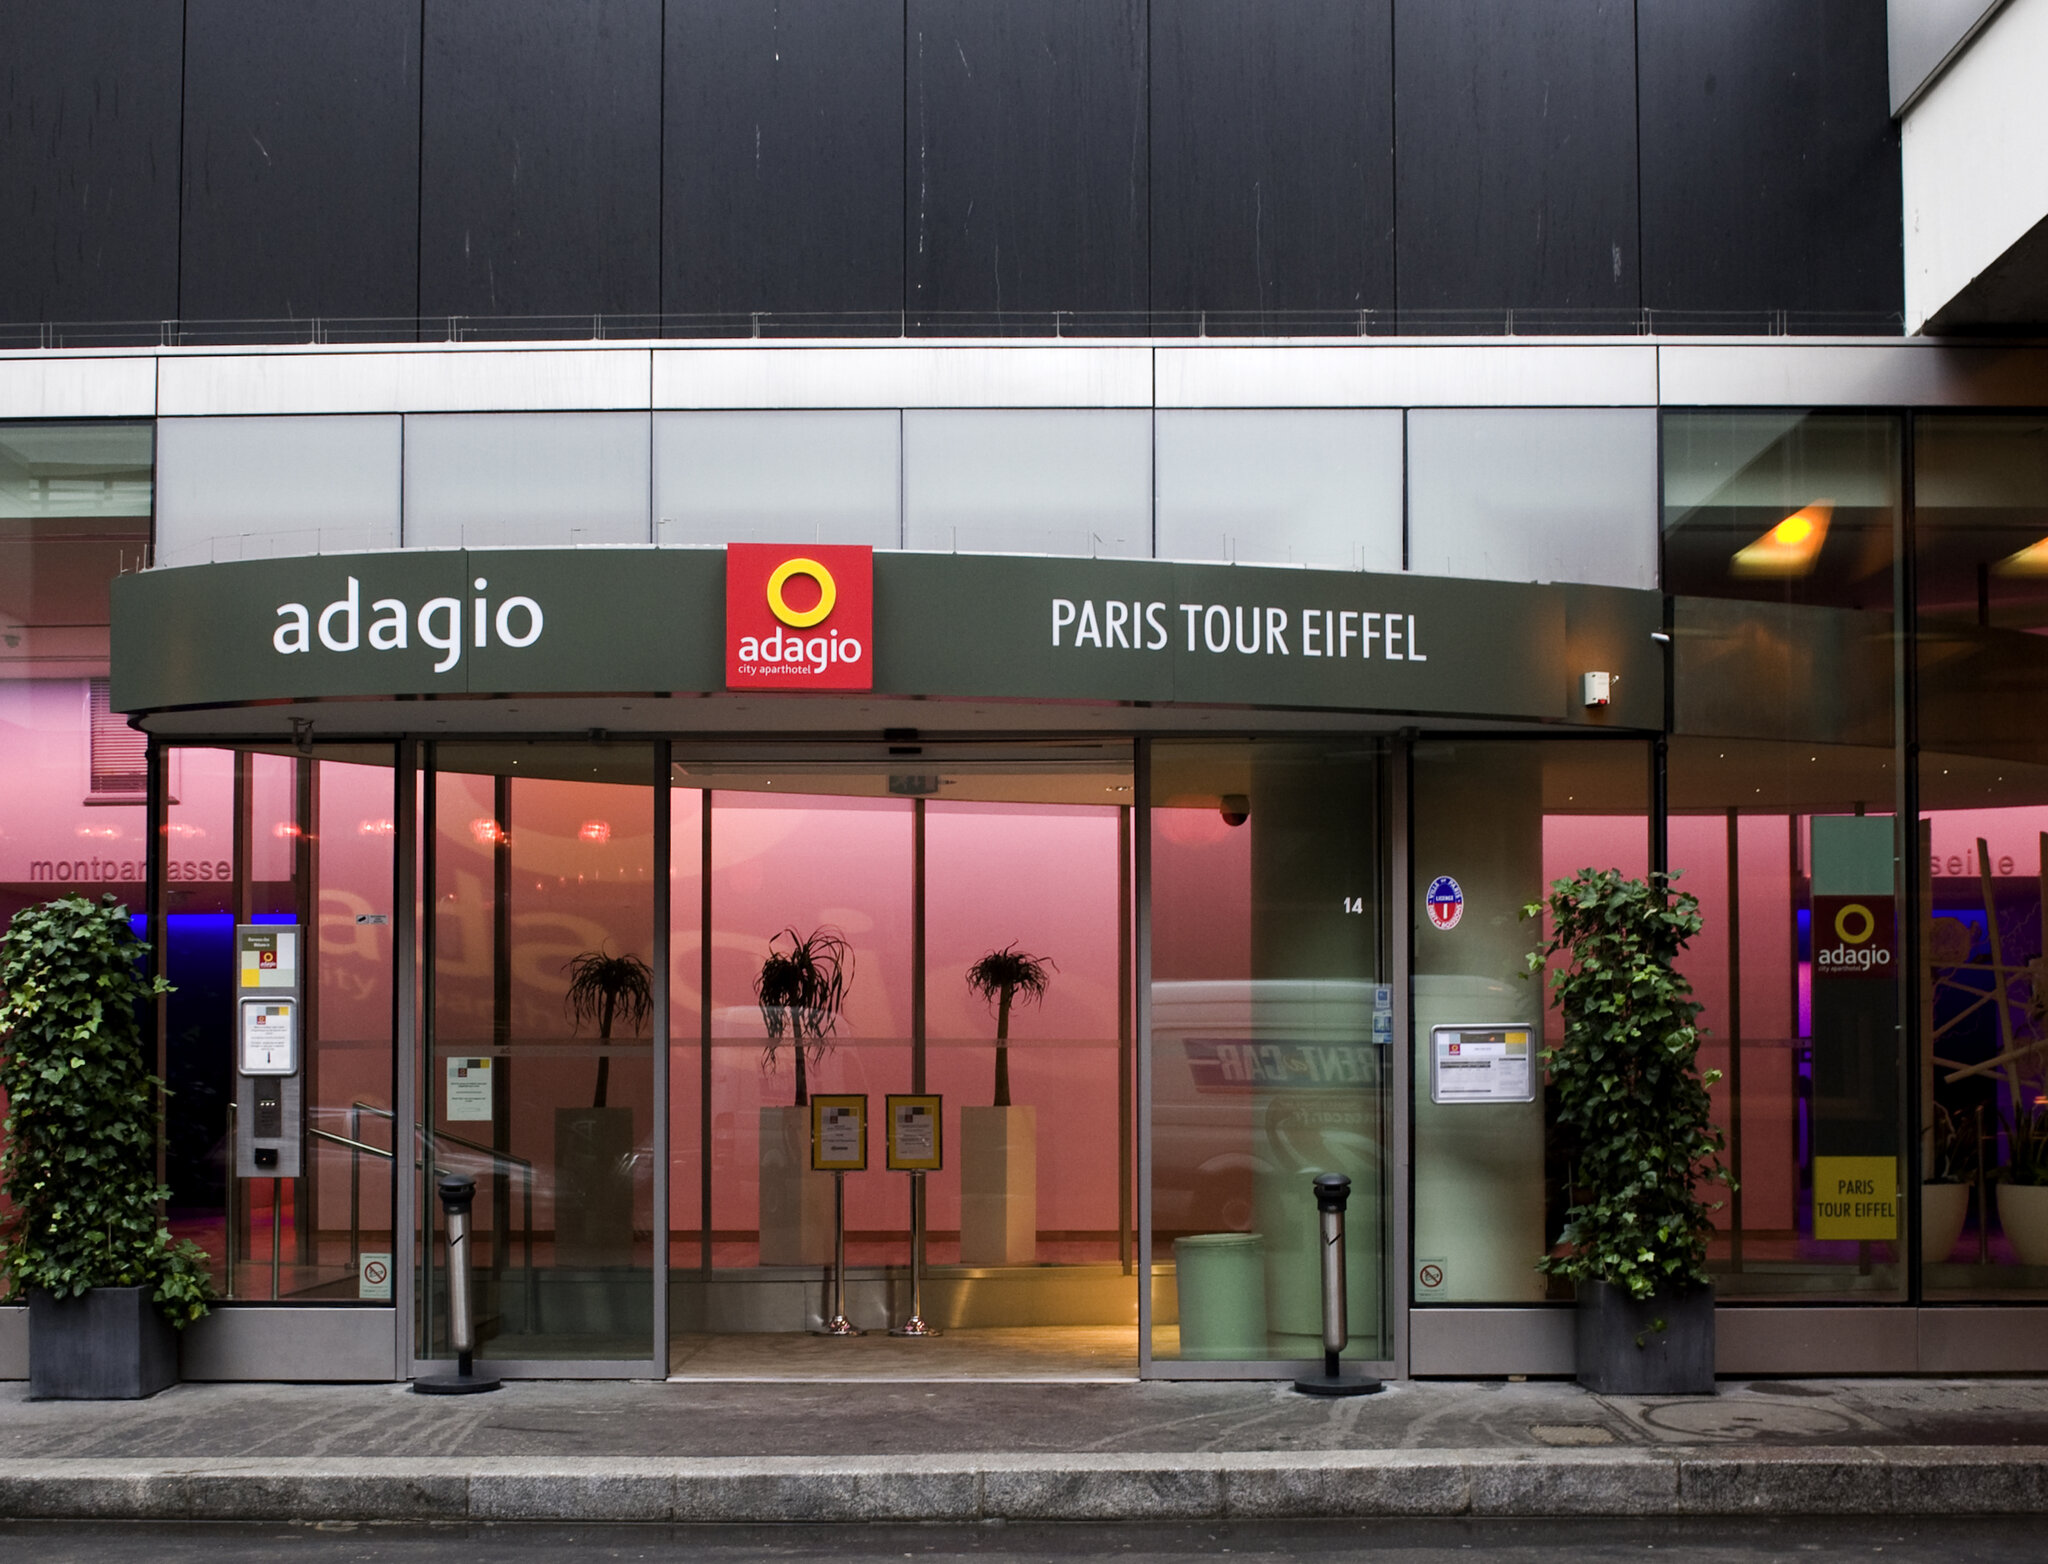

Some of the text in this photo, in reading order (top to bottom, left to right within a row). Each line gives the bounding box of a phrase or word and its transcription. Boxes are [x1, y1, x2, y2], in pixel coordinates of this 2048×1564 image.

[273, 576, 544, 673] adagio
[1052, 599, 1427, 663] PARIS TOUR EIFFEL
[738, 626, 862, 674] adagio
[738, 664, 811, 676] city aparthotel
[30, 856, 231, 882] montparasse
[1931, 848, 2014, 875] seie
[1343, 897, 1363, 914] 14
[1818, 943, 1890, 971] adagio
[1838, 1180, 1874, 1195] PARIS
[1817, 1202, 1896, 1218] TOUR EIFFEL
